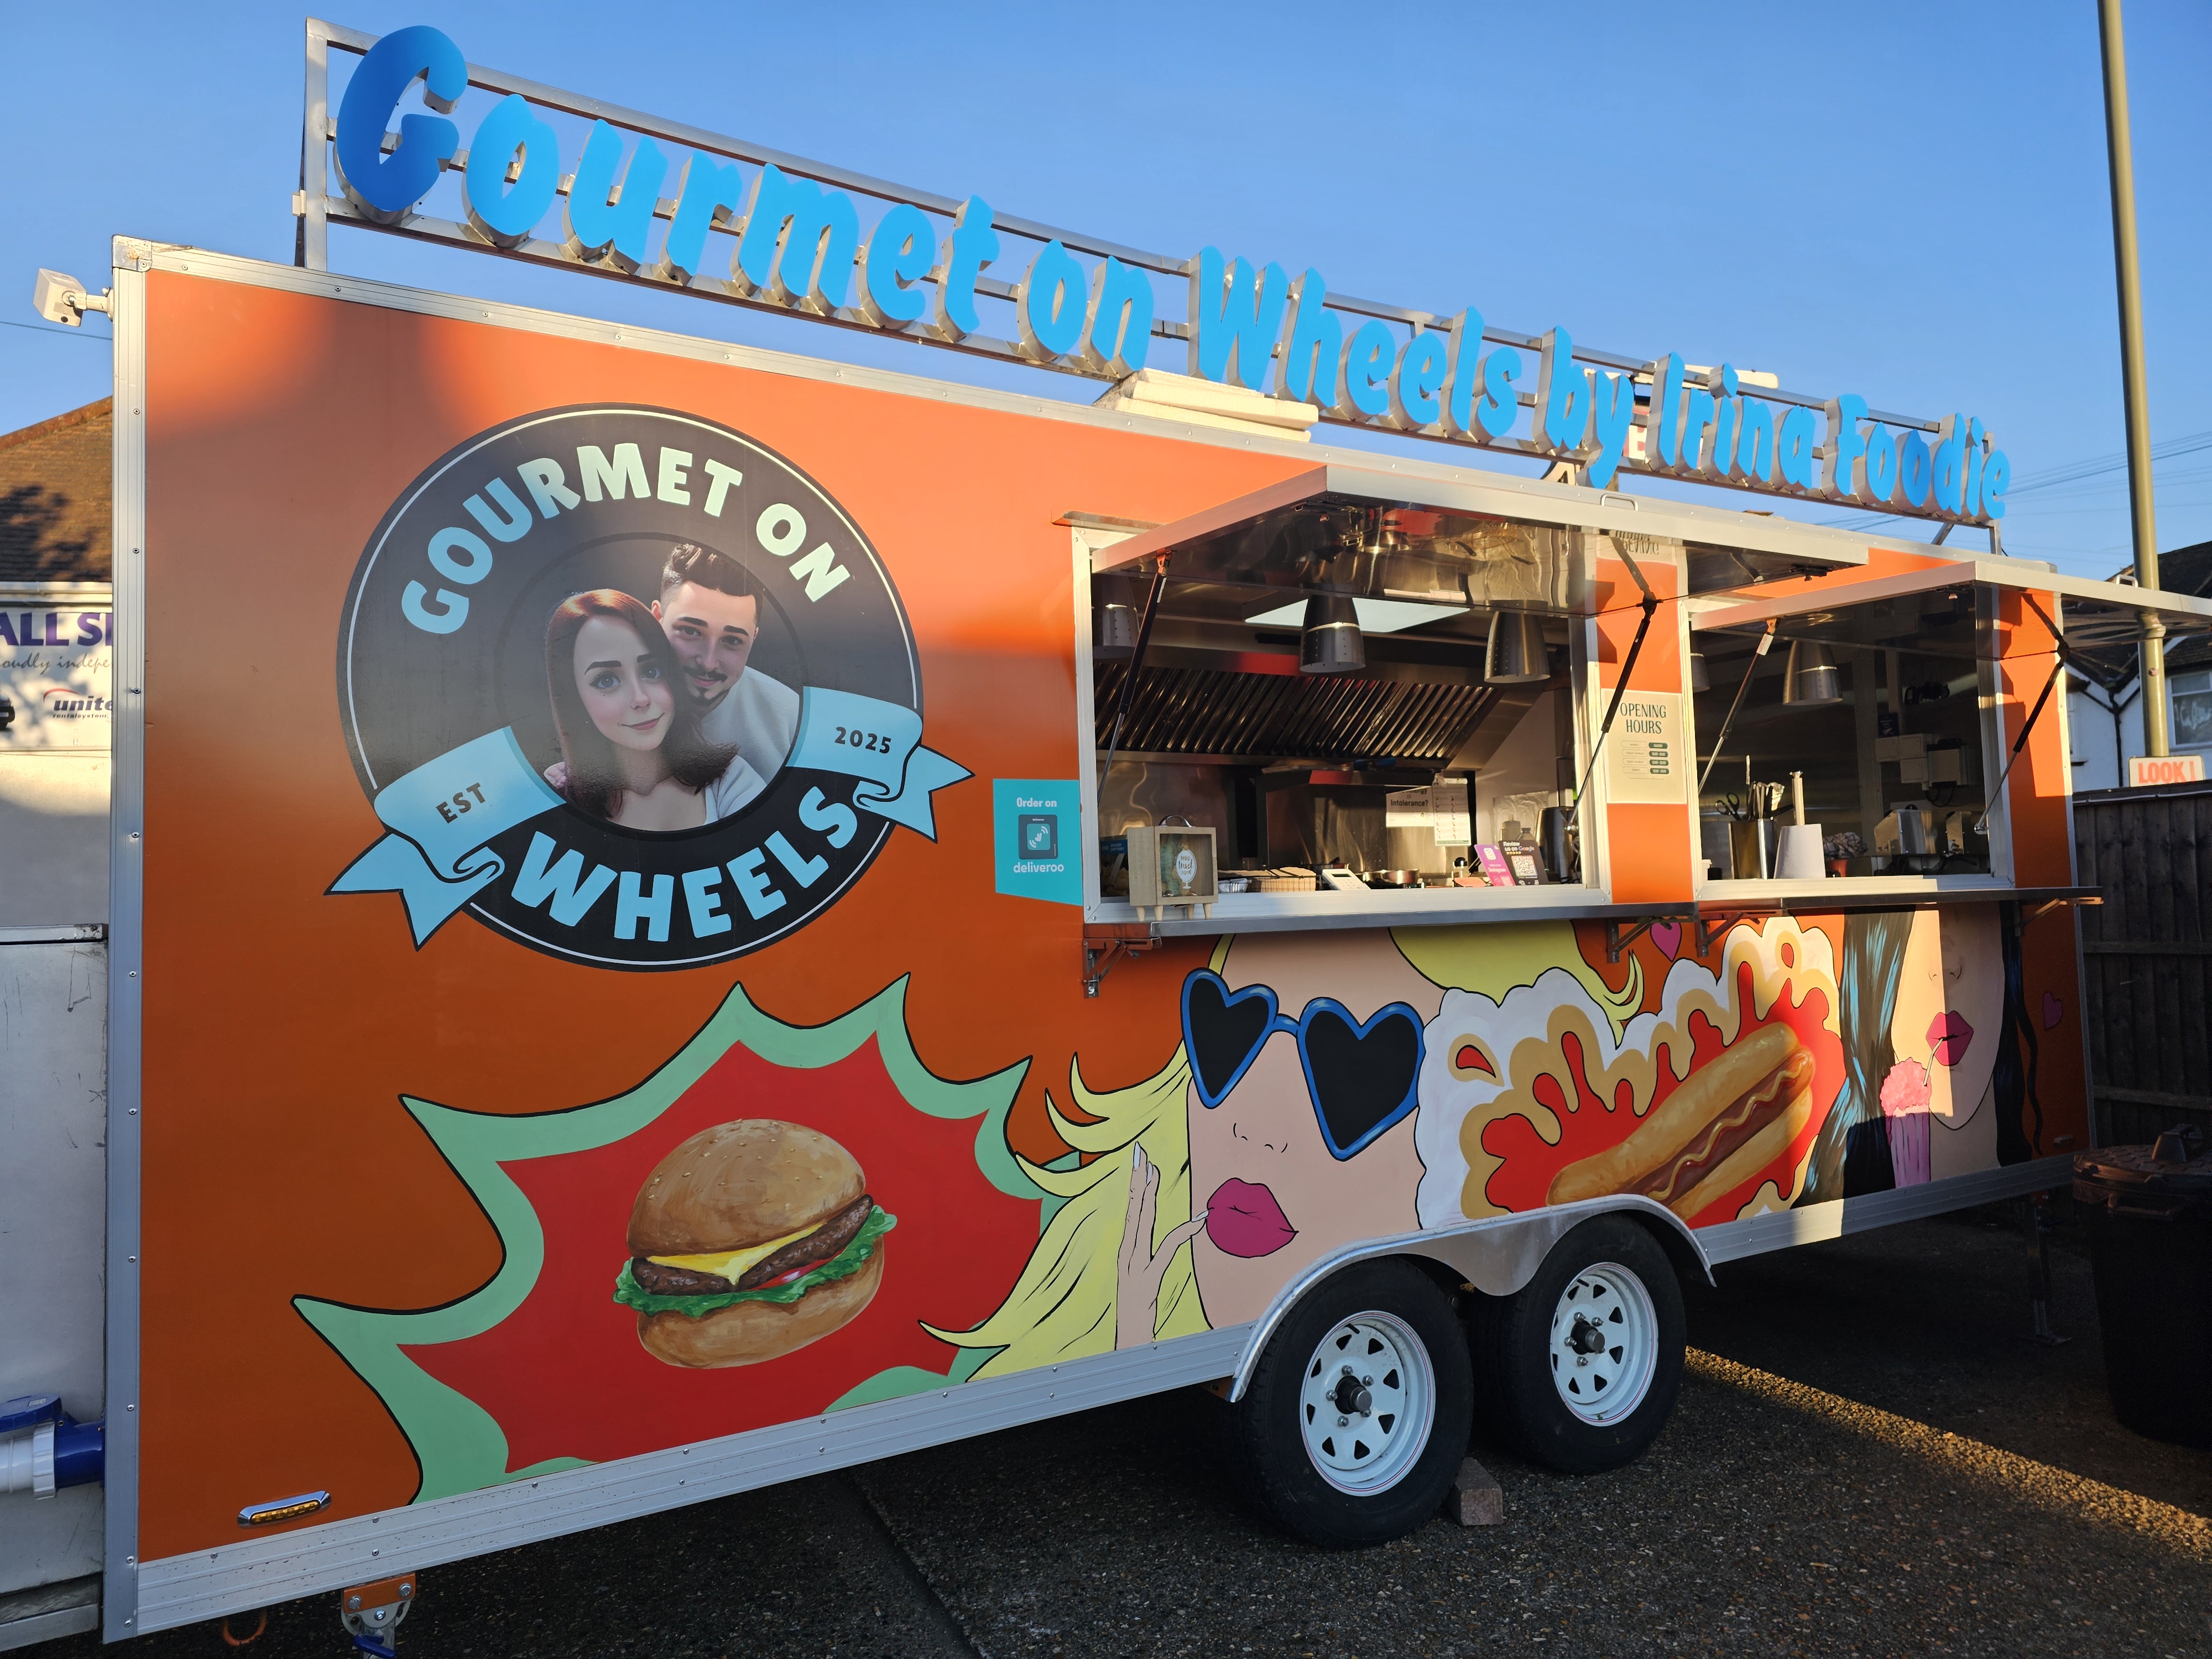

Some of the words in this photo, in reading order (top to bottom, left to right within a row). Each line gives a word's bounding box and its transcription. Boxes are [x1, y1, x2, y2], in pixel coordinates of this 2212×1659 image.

[334, 25, 1000, 338] Gourmet
[1023, 239, 1154, 375] on
[1193, 246, 1522, 439] Wheels
[1537, 325, 1633, 489] by
[1651, 352, 1815, 489] Irina
[1825, 394, 2010, 519] Foodie
[401, 443, 743, 634] GOURMET
[755, 503, 851, 603] ON
[1620, 702, 1667, 718] OPENING
[833, 726, 893, 755] 2025
[1626, 719, 1662, 734] HOURS
[435, 782, 487, 825] EST
[1016, 797, 1043, 807] Order
[511, 786, 859, 942] WHEELS
[1013, 862, 1065, 873] deliveroo
